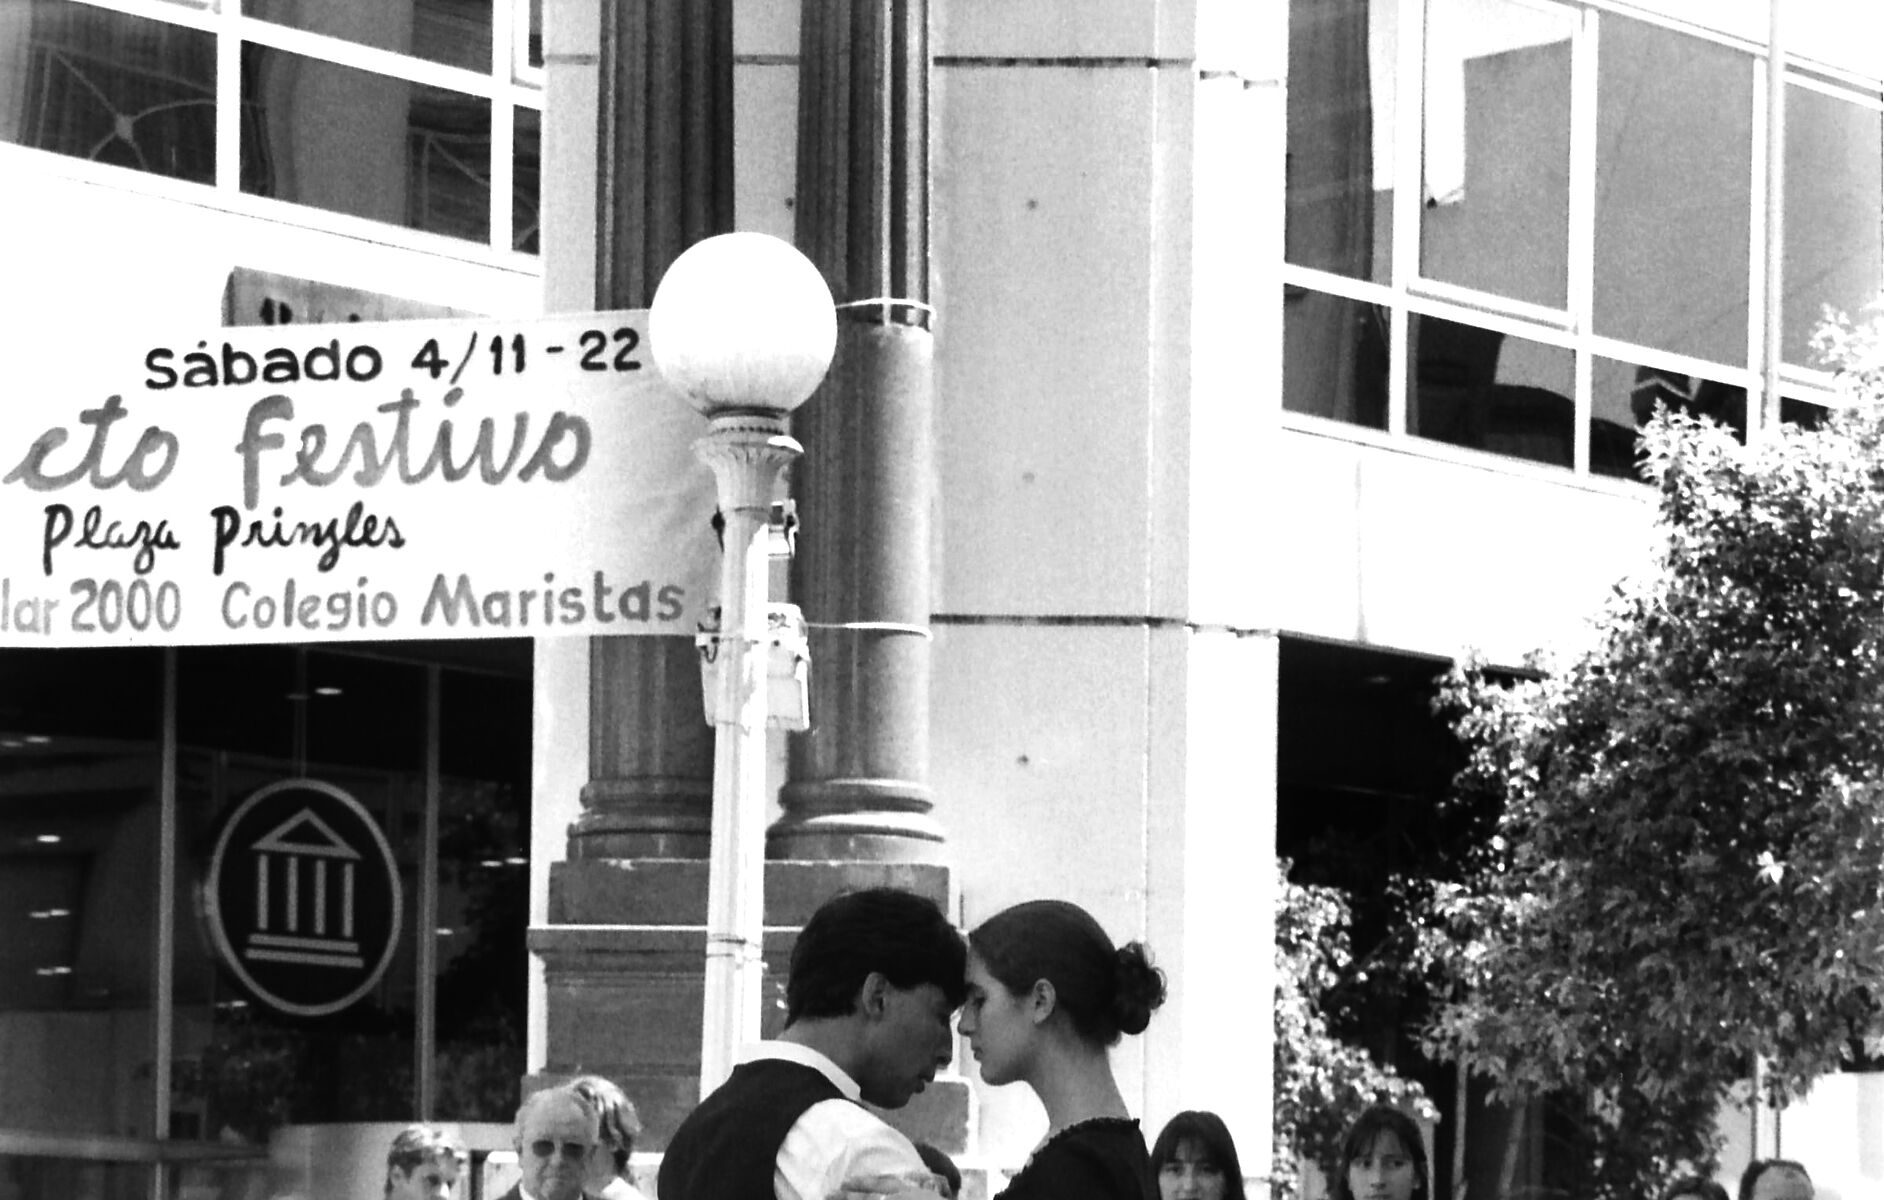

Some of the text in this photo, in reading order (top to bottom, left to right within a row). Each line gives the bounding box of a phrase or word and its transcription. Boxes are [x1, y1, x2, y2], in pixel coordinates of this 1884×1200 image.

[145, 339, 383, 390] Sábado
[2, 394, 180, 492] cto
[42, 500, 406, 577] Plaza Pringles
[1, 570, 685, 636] lar 2000 Colegio Maristas
